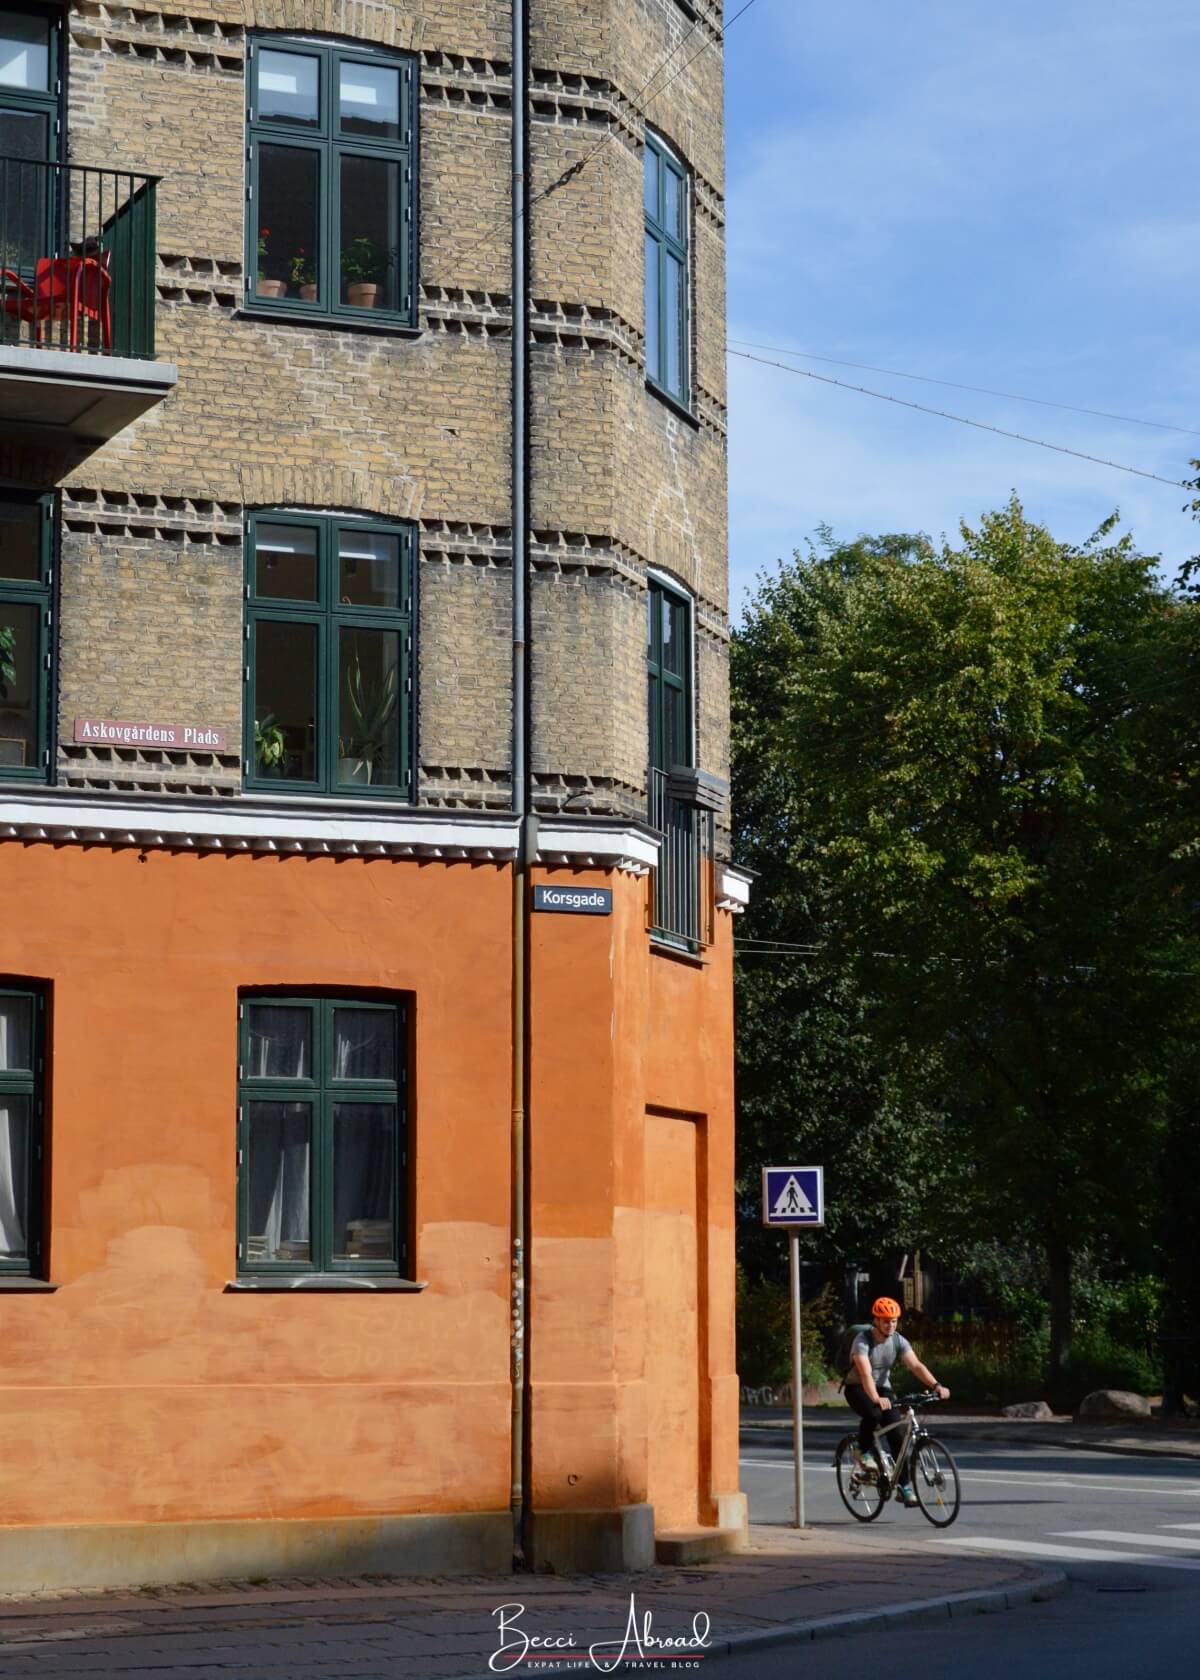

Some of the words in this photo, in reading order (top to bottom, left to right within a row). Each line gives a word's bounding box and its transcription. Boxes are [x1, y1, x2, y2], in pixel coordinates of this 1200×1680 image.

[82, 721, 175, 742] Askovgårdens
[183, 727, 220, 745] Plads
[543, 890, 605, 908] Korsgade
